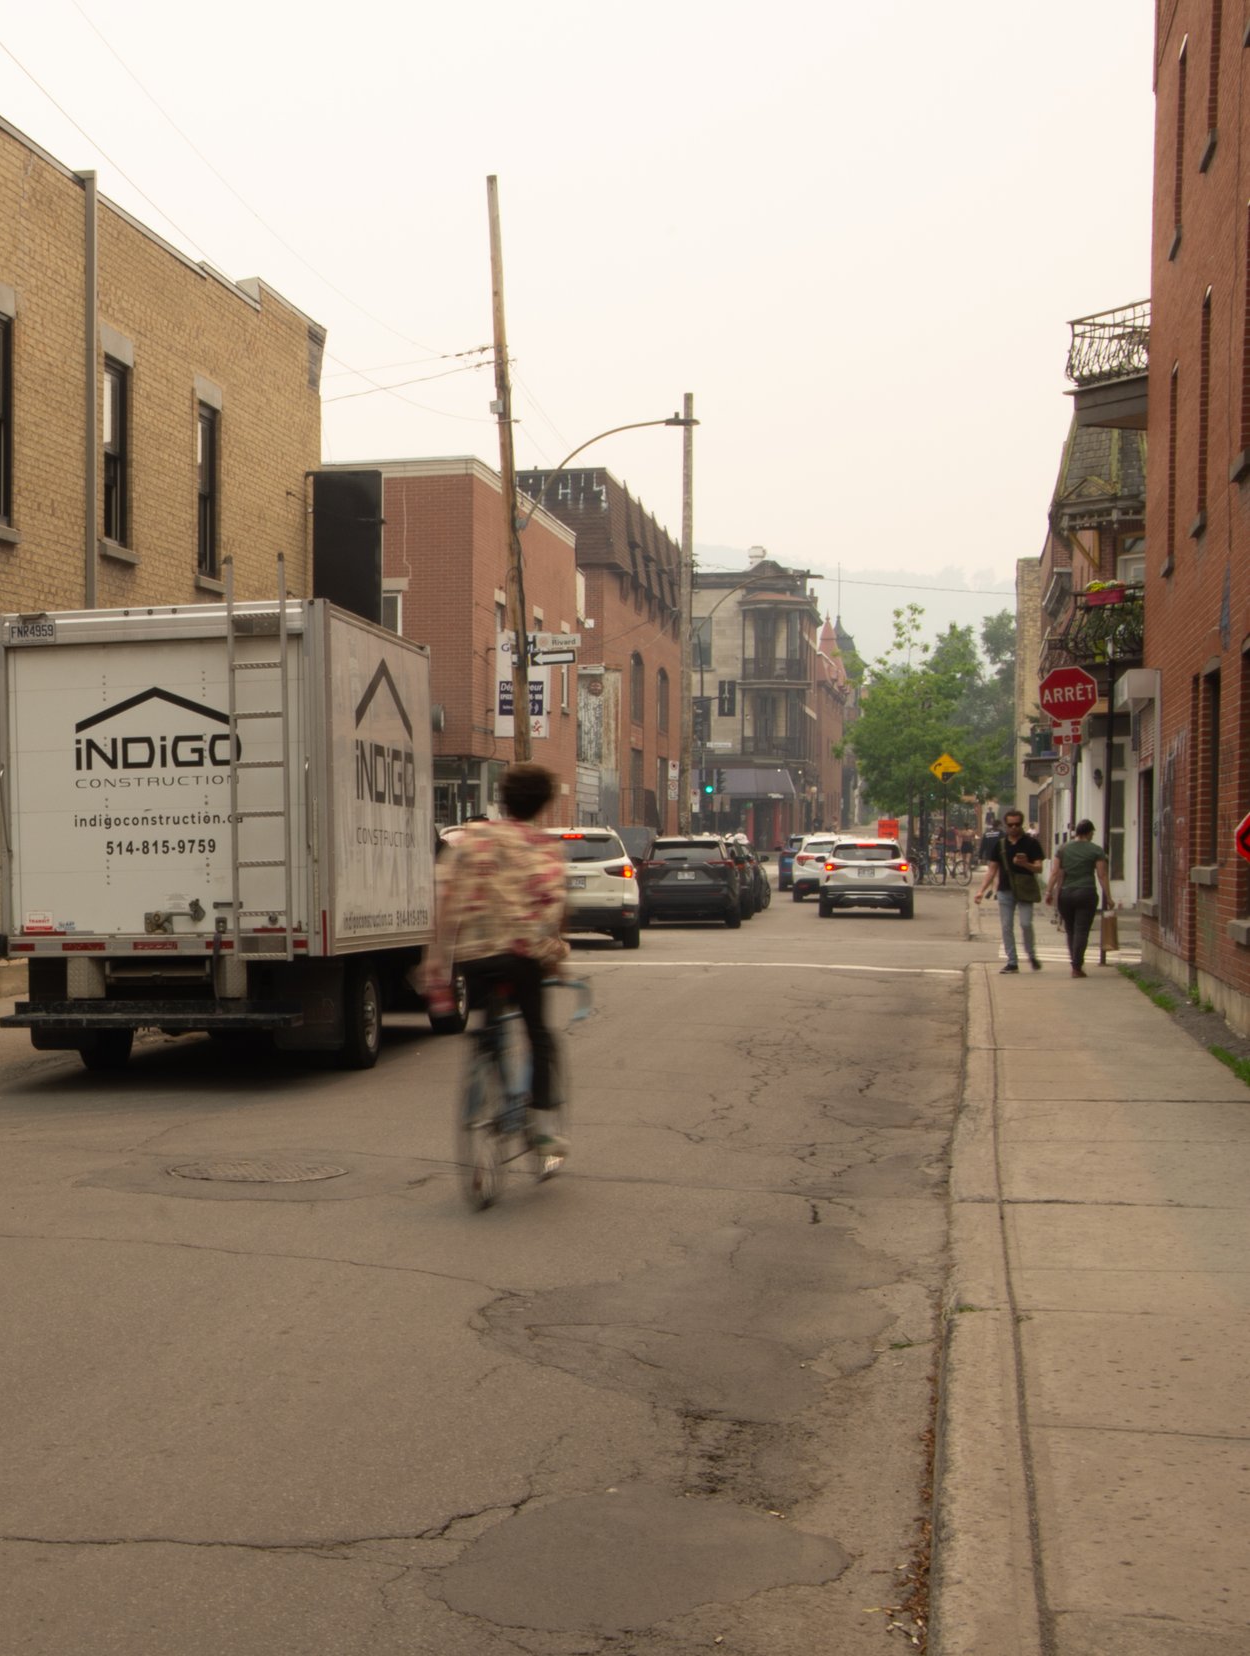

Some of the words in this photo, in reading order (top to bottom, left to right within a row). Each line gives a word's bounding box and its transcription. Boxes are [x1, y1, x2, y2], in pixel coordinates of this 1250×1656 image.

[11, 624, 54, 639] FNR4959
[552, 637, 577, 647] Rivard
[1042, 682, 1094, 705] ARRÊT
[106, 839, 216, 855] 514-815-9759
